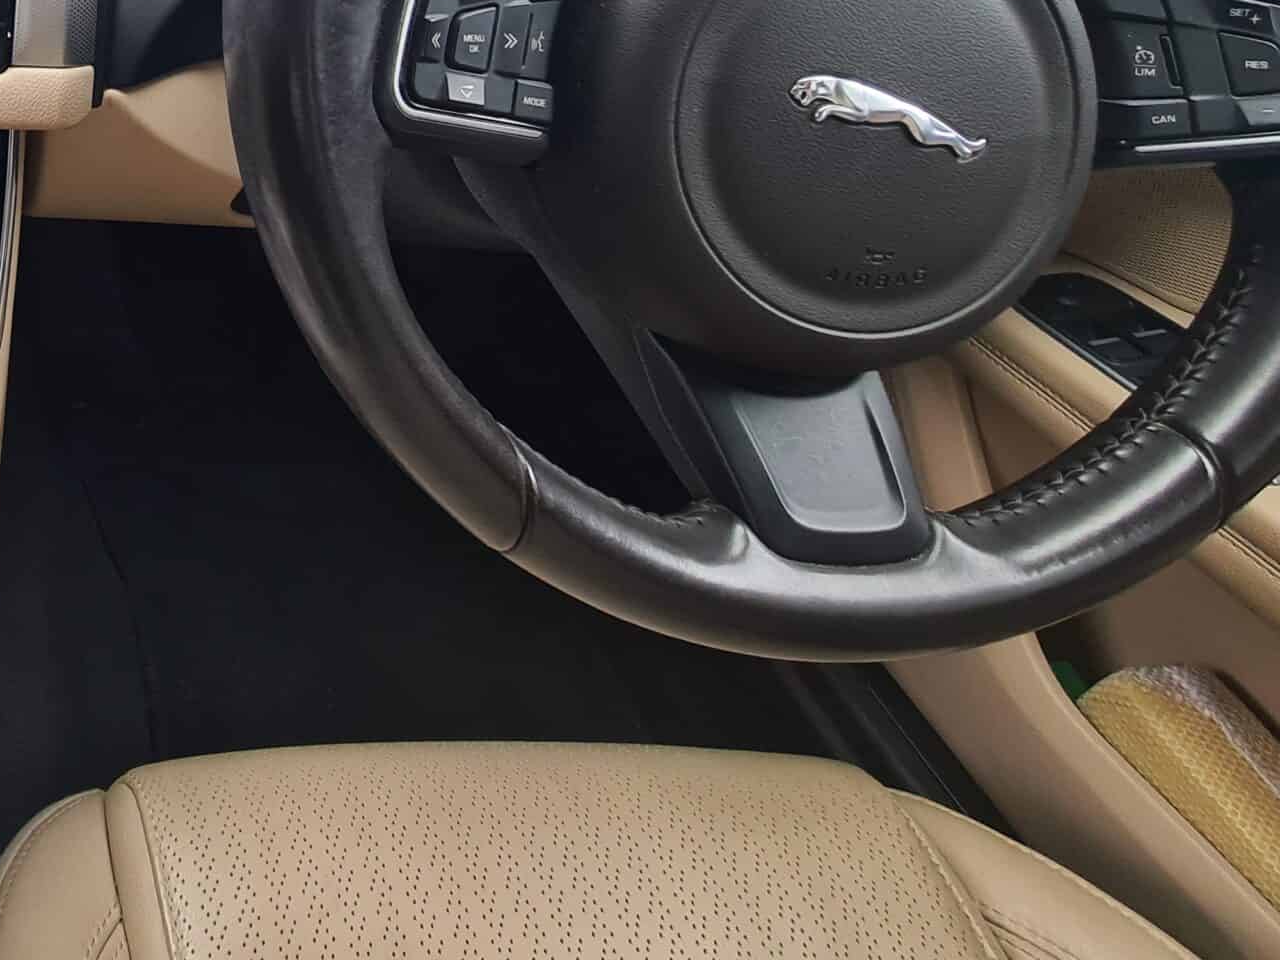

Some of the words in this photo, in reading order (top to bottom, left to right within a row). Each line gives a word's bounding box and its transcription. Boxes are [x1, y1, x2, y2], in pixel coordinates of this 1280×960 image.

[1229, 8, 1251, 17] SET
[463, 35, 486, 43] MENU
[468, 44, 480, 54] OK
[1244, 60, 1270, 70] RES
[1134, 68, 1156, 77] LIM
[523, 96, 547, 108] MODE
[1151, 114, 1177, 125] CAN
